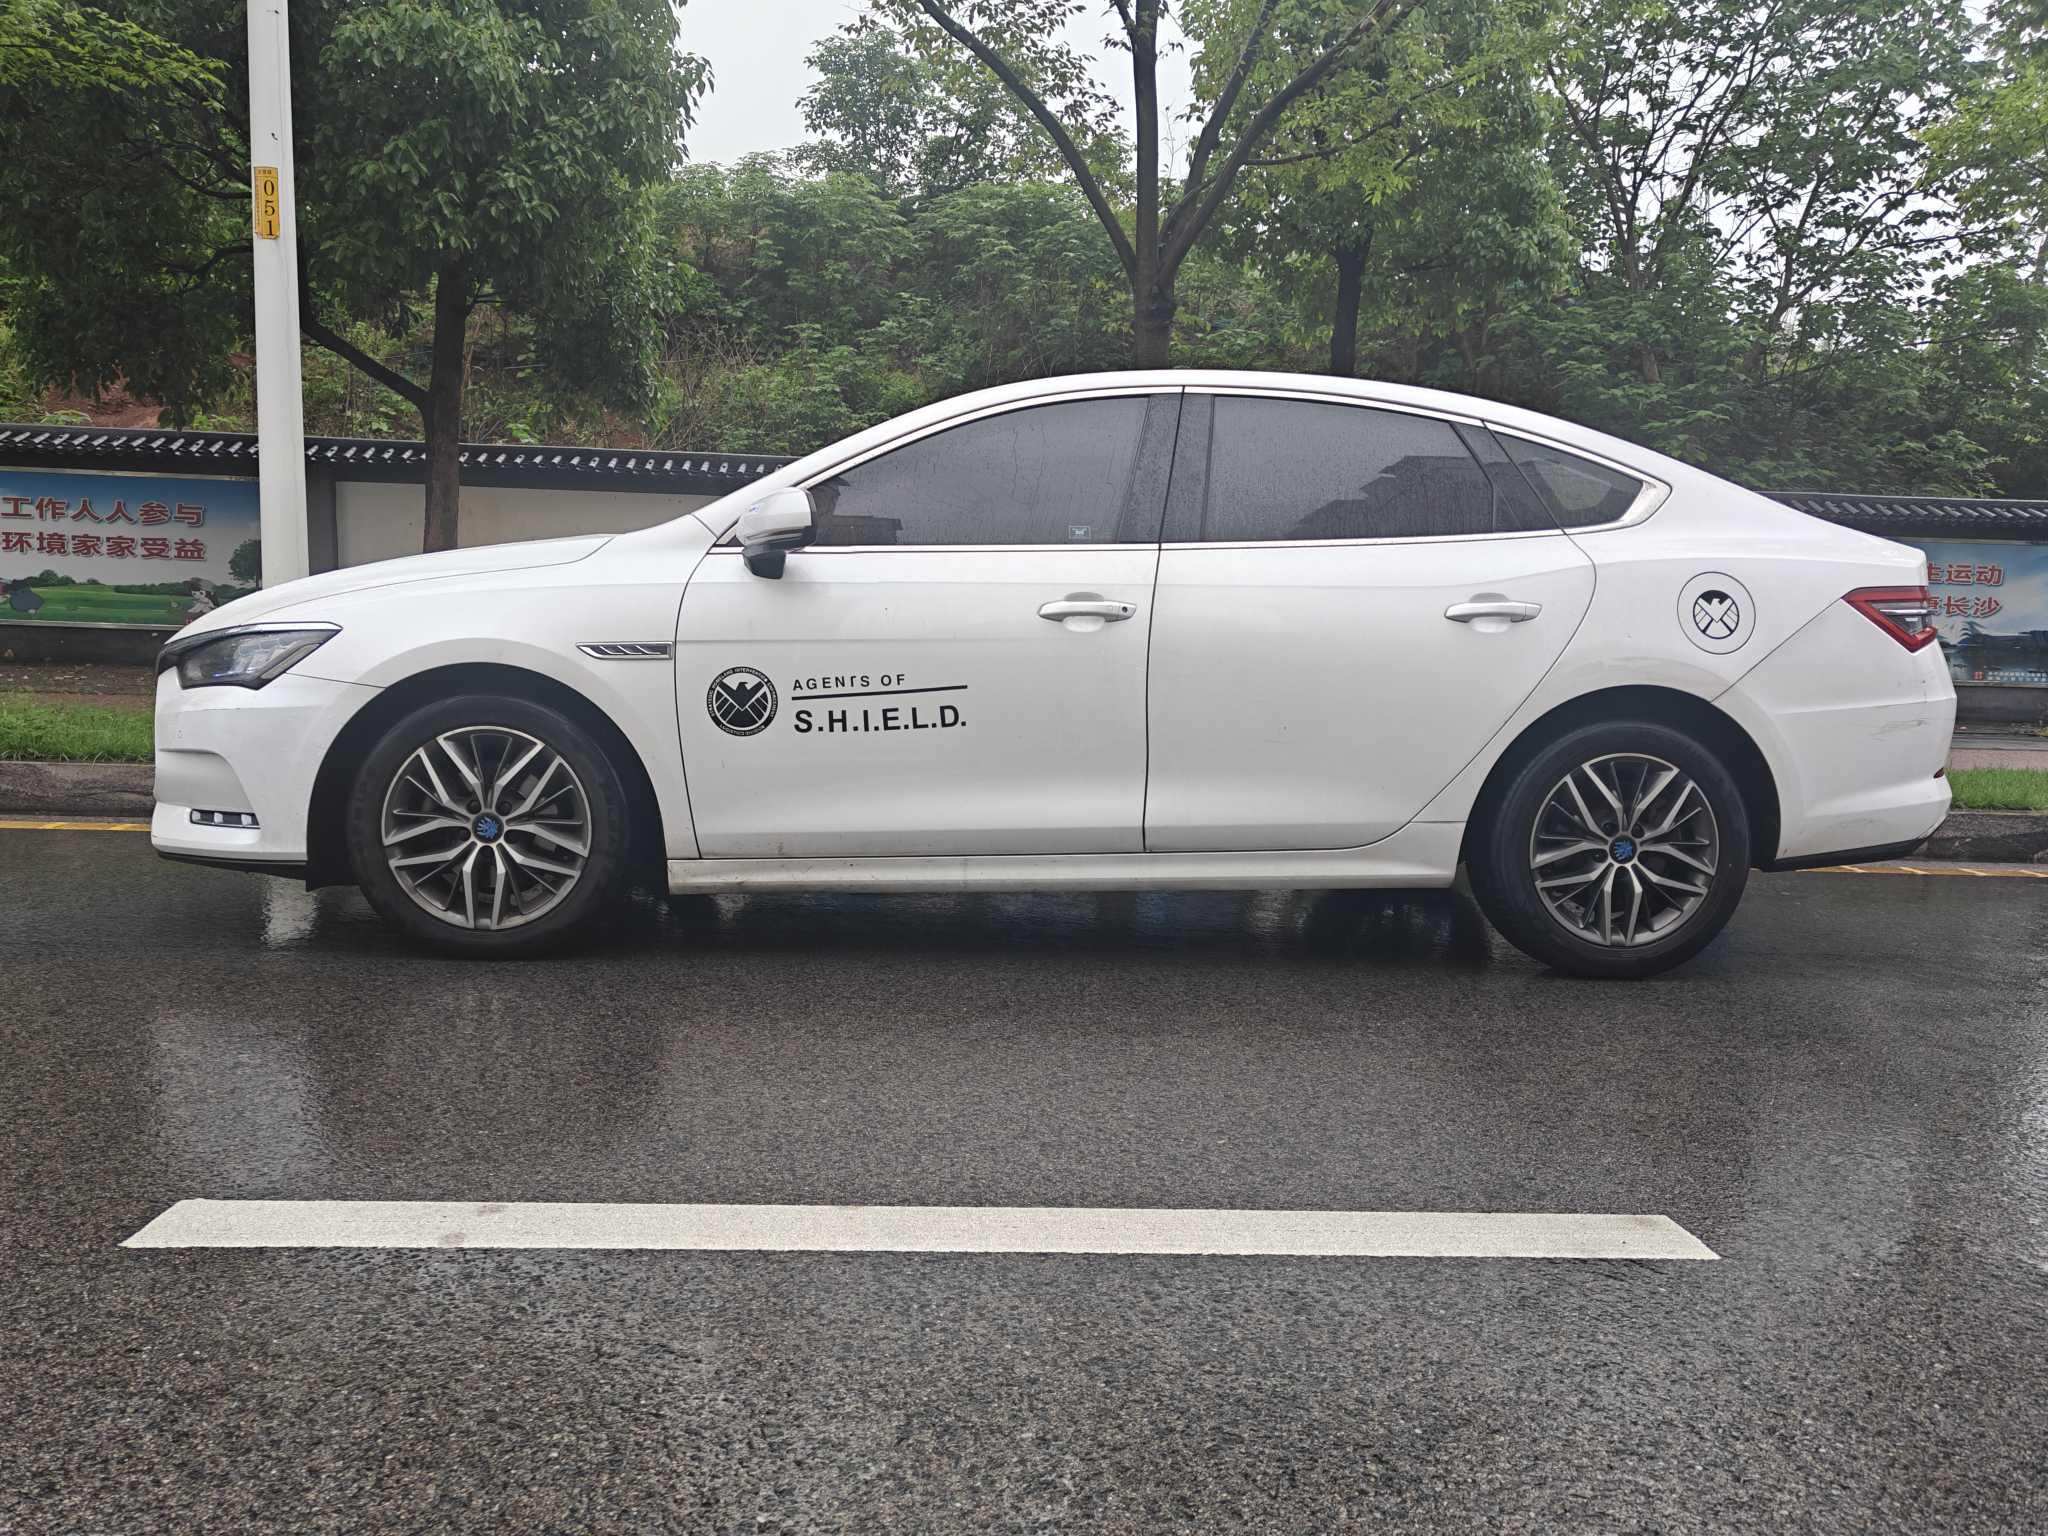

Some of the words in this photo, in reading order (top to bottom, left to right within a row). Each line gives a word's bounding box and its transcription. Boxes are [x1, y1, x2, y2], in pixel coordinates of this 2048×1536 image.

[263, 179, 275, 236] 051
[1, 496, 204, 526] 工作人人参与
[1, 532, 205, 560] 环境家家受益
[793, 675, 870, 691] AGENTS
[880, 674, 905, 687] OF
[793, 705, 967, 733] S.H.I.E.L.D.
